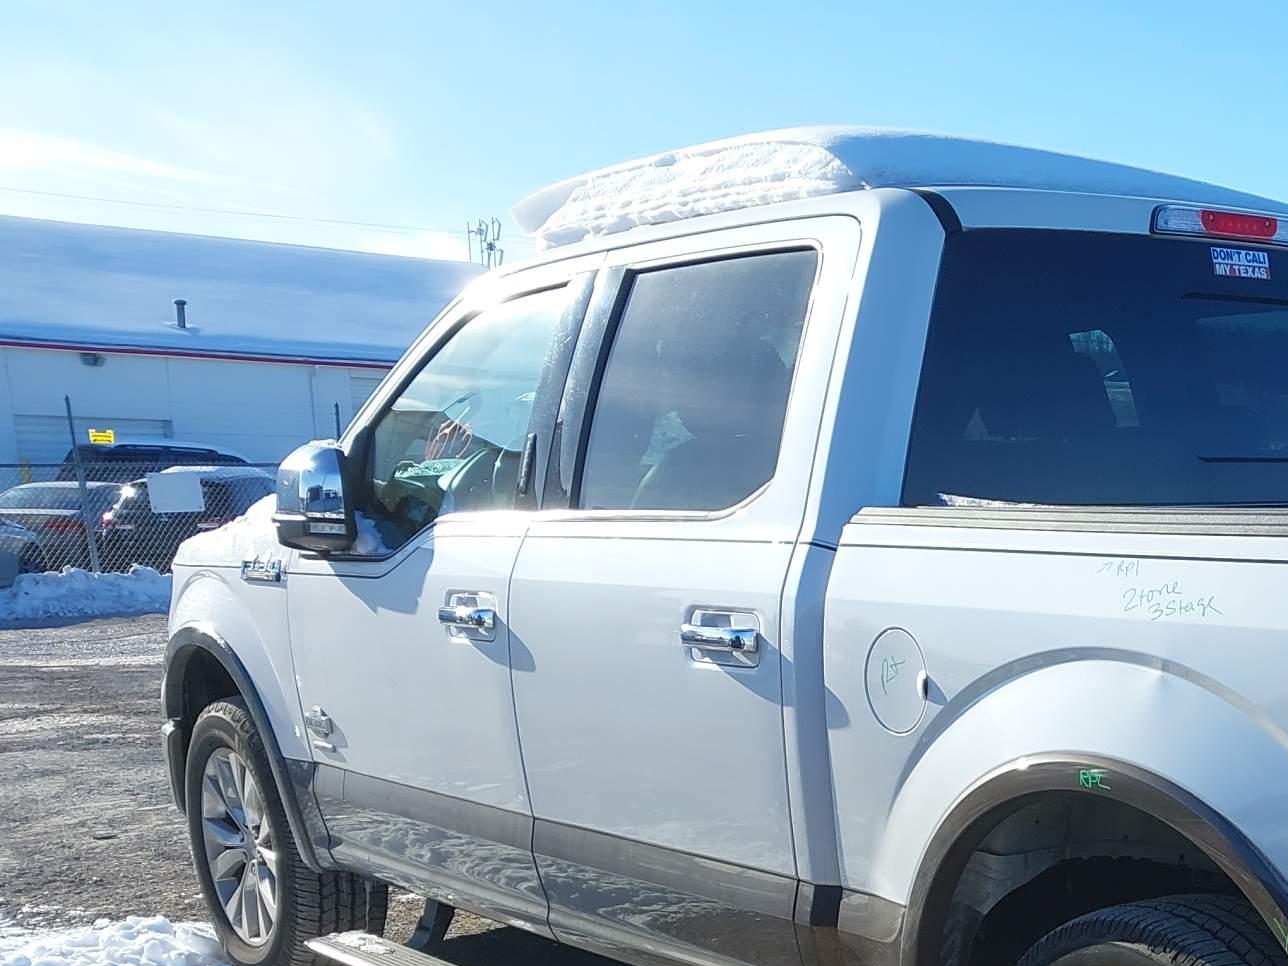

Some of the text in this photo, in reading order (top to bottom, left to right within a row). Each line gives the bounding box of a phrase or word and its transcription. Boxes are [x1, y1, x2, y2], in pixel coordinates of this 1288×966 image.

[1212, 248, 1267, 264] DON'T CALI
[1215, 263, 1268, 279] MY TEXAS
